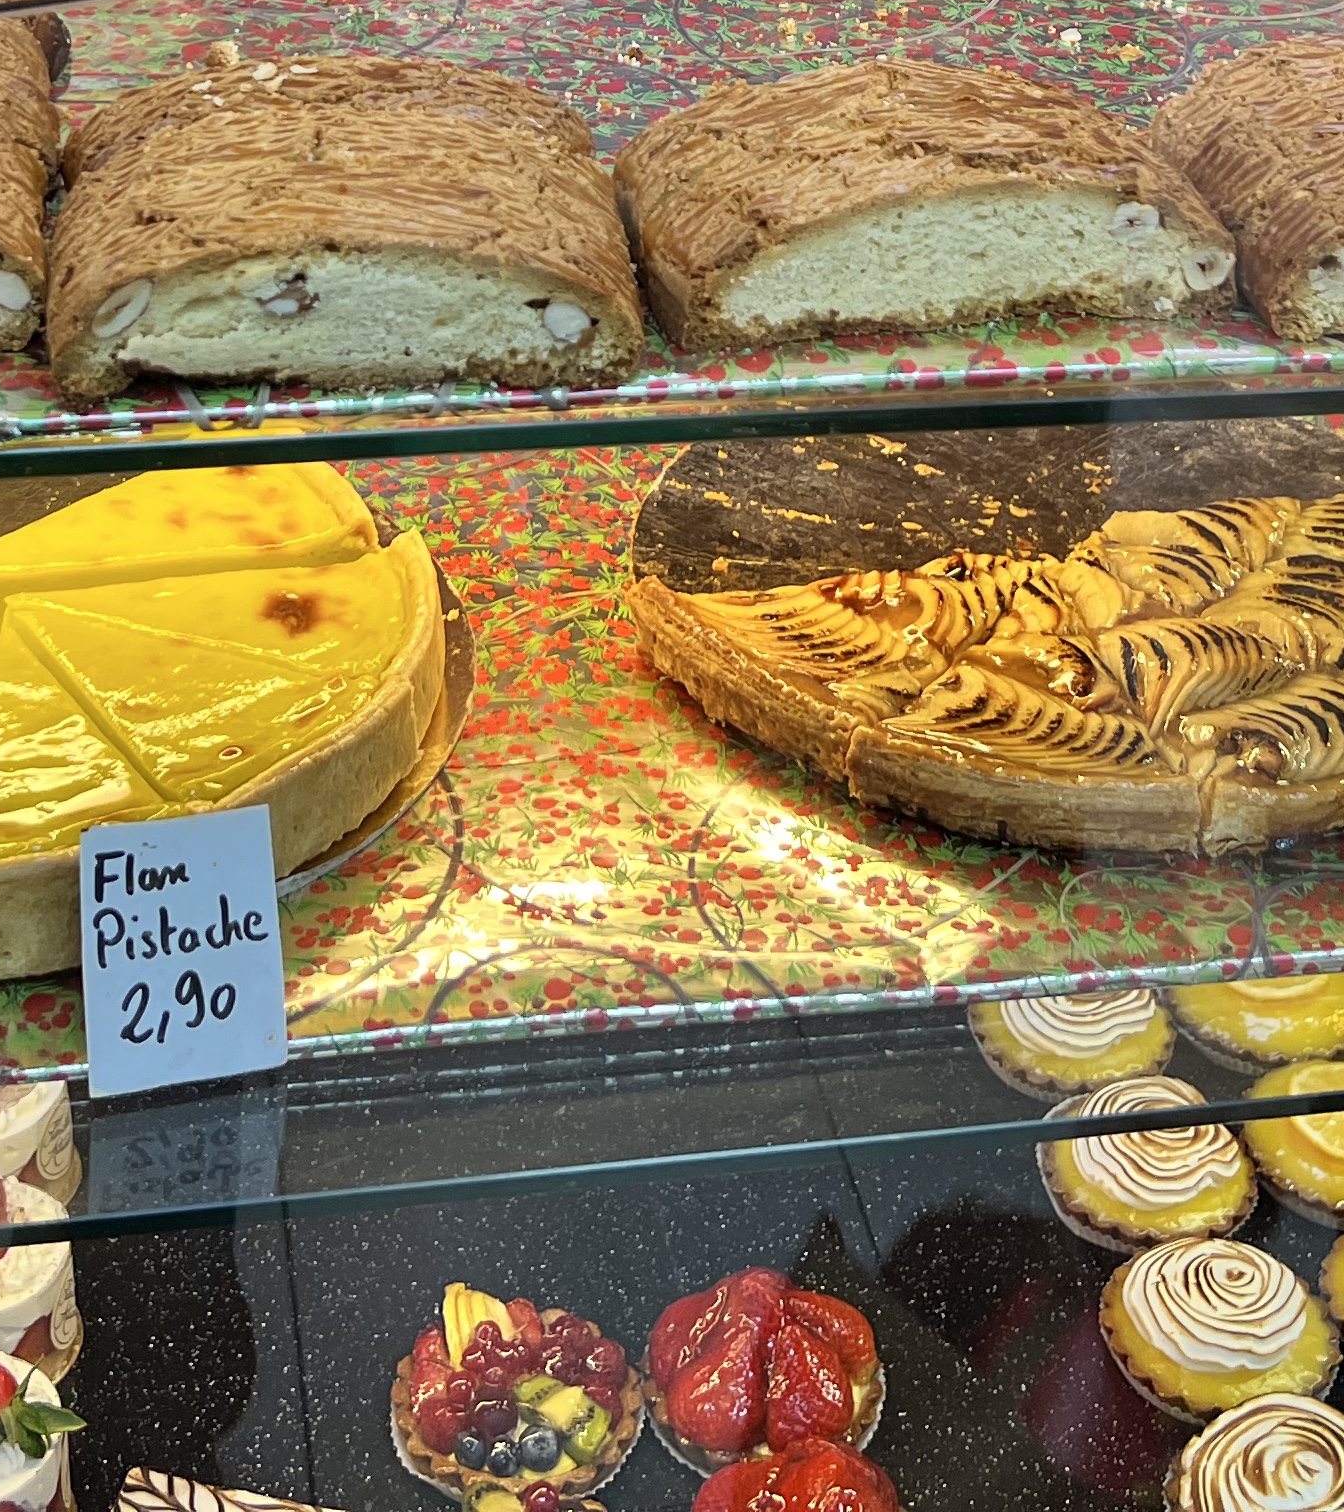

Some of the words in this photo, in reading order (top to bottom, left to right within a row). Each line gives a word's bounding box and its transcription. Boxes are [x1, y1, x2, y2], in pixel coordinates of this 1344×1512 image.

[94, 850, 191, 904] Flan
[92, 893, 270, 969] Pistache
[119, 968, 237, 1045] 2,90
